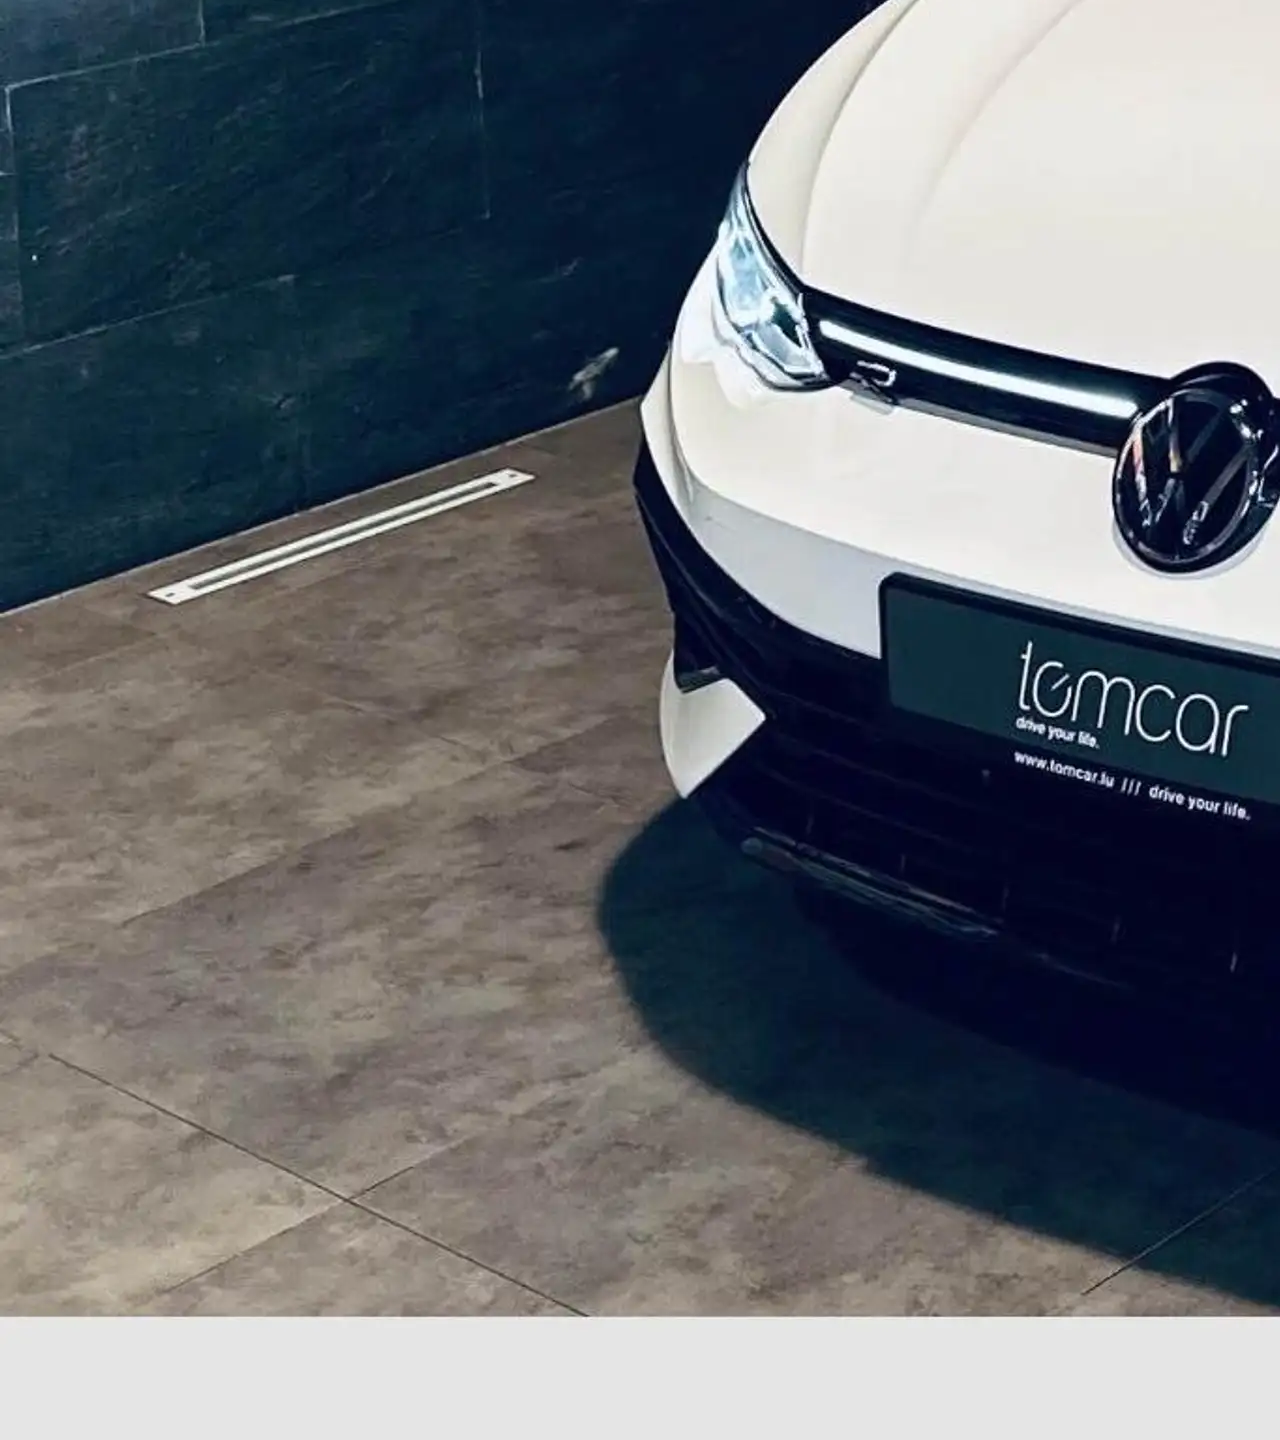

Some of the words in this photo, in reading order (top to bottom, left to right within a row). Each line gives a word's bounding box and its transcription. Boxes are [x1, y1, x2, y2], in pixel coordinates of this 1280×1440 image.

[1015, 716, 1046, 735] drive
[1048, 725, 1077, 741] your
[1018, 641, 1249, 757] tomcar
[1014, 751, 1115, 788] www.tomcar.lu
[1148, 784, 1185, 805] drive
[1187, 795, 1221, 813] your
[1222, 801, 1251, 821] life.
